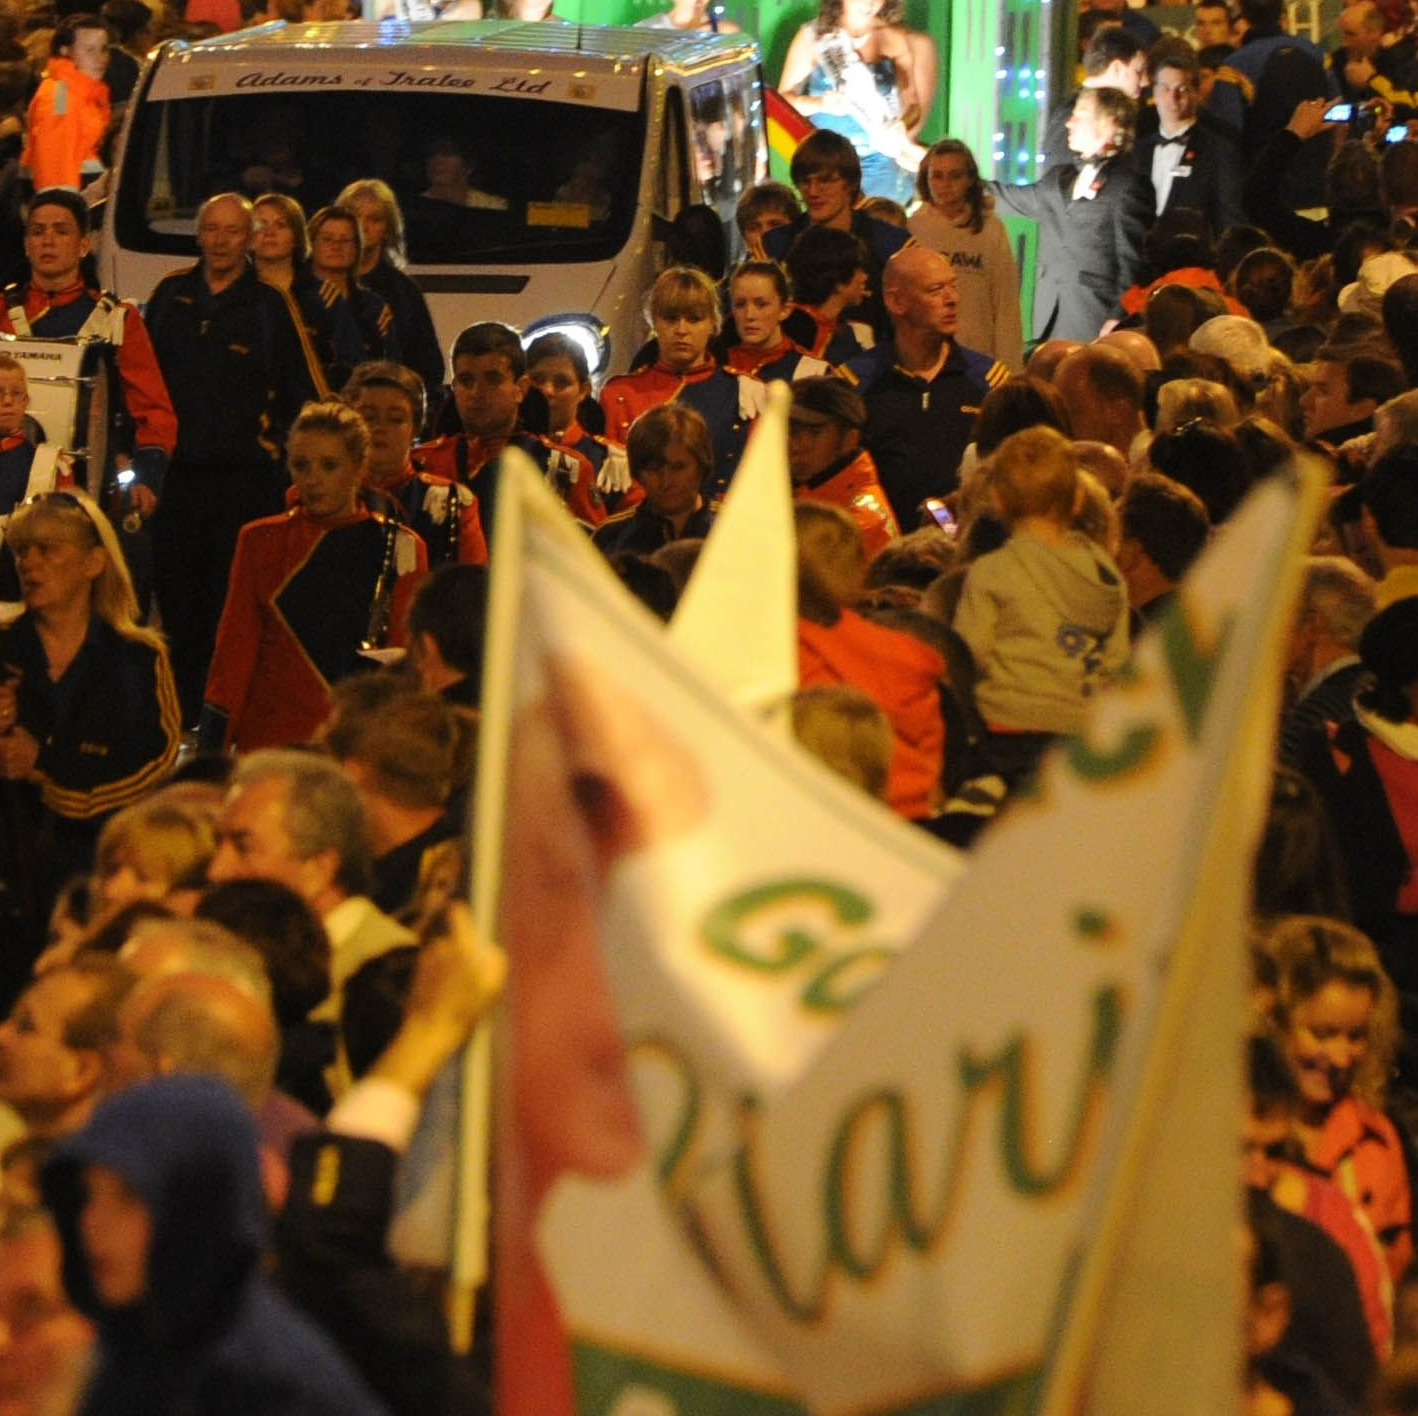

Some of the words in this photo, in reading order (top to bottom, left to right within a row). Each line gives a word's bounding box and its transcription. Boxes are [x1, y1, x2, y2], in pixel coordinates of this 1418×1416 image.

[236, 71, 343, 89] Adams
[379, 71, 476, 90] Tralee
[489, 76, 552, 95] Ltd
[13, 351, 62, 361] YAMAHA
